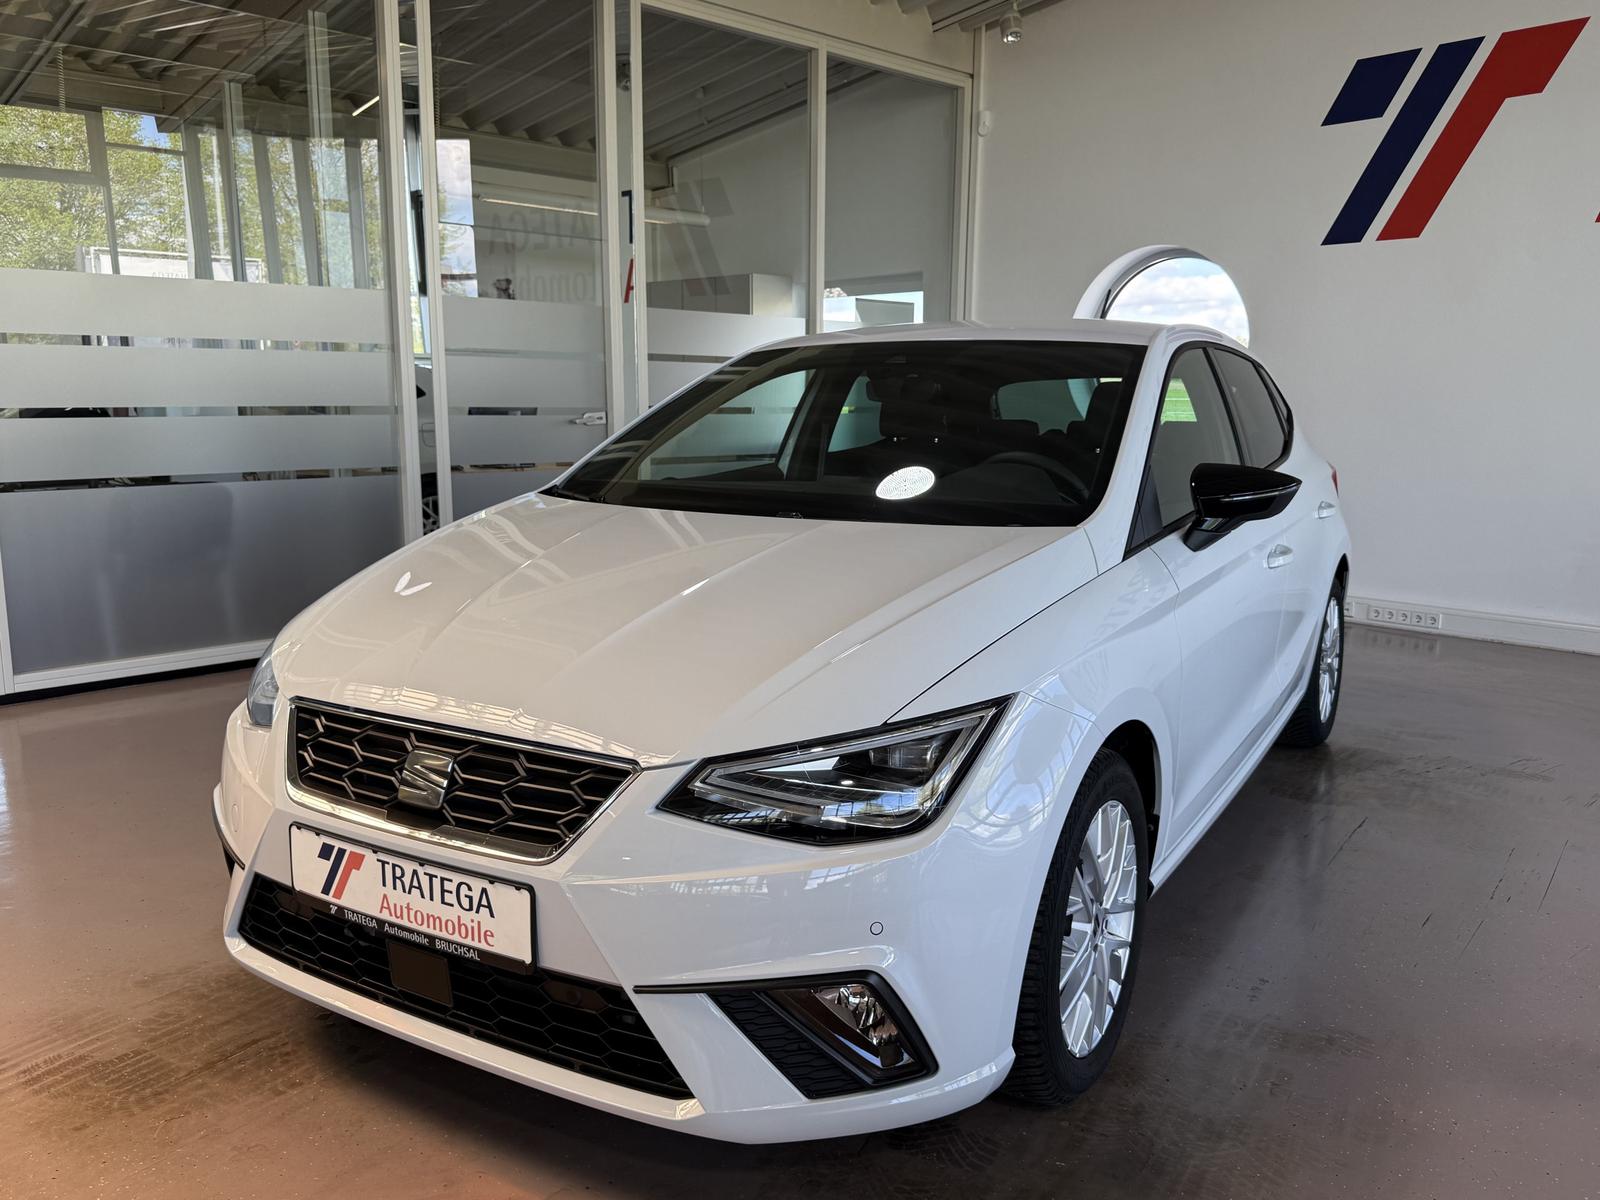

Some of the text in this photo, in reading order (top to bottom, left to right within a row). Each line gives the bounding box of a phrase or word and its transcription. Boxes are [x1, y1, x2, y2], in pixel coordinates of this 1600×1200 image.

[376, 858, 496, 919] TRATEGA
[343, 909, 378, 929] TRATEGA
[384, 922, 430, 946] Automobile
[435, 938, 481, 961] BRUCHSAL
[379, 893, 496, 948] Automobile
